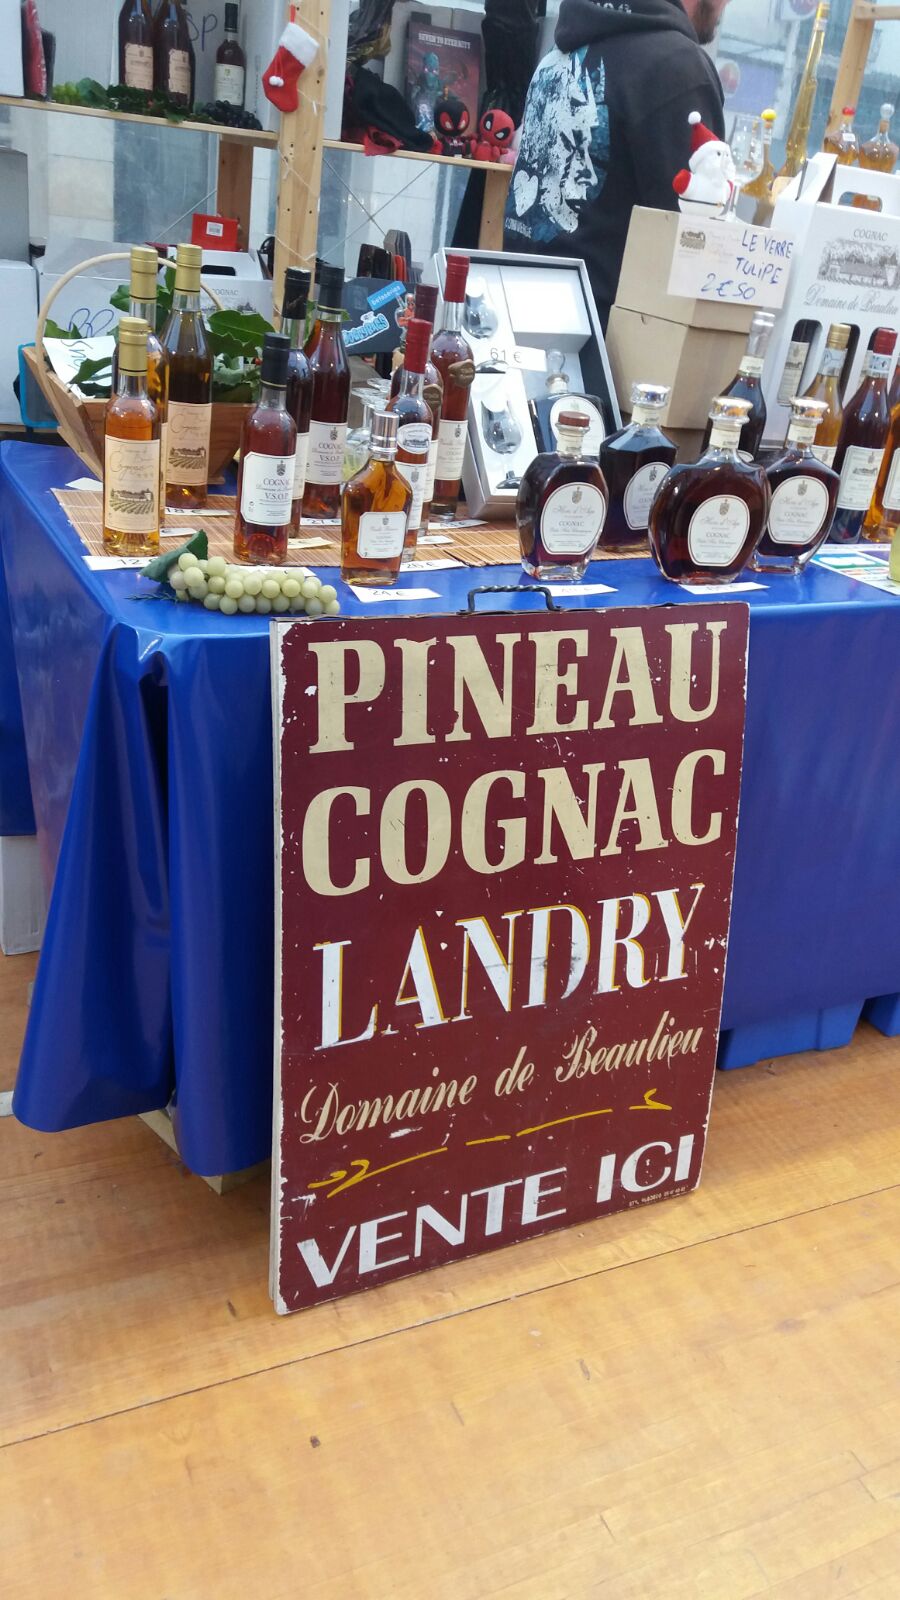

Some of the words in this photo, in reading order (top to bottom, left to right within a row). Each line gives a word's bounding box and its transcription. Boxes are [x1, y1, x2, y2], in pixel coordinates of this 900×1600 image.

[741, 230, 758, 252] LE
[764, 236, 794, 259] VERRE
[803, 283, 848, 309] Domaine
[848, 296, 859, 311] de
[853, 229, 888, 242] COGNAC
[490, 347, 506, 361] 61
[513, 351, 522, 364] €
[307, 620, 728, 755] PINEAU
[301, 748, 727, 897] COGNAC
[313, 882, 706, 1051] LANDRY
[300, 1066, 477, 1144] Domaine
[495, 1045, 535, 1097] de
[555, 1010, 704, 1082] Beaulieu
[296, 1166, 567, 1288] VENTE
[595, 1133, 695, 1203] ICI
